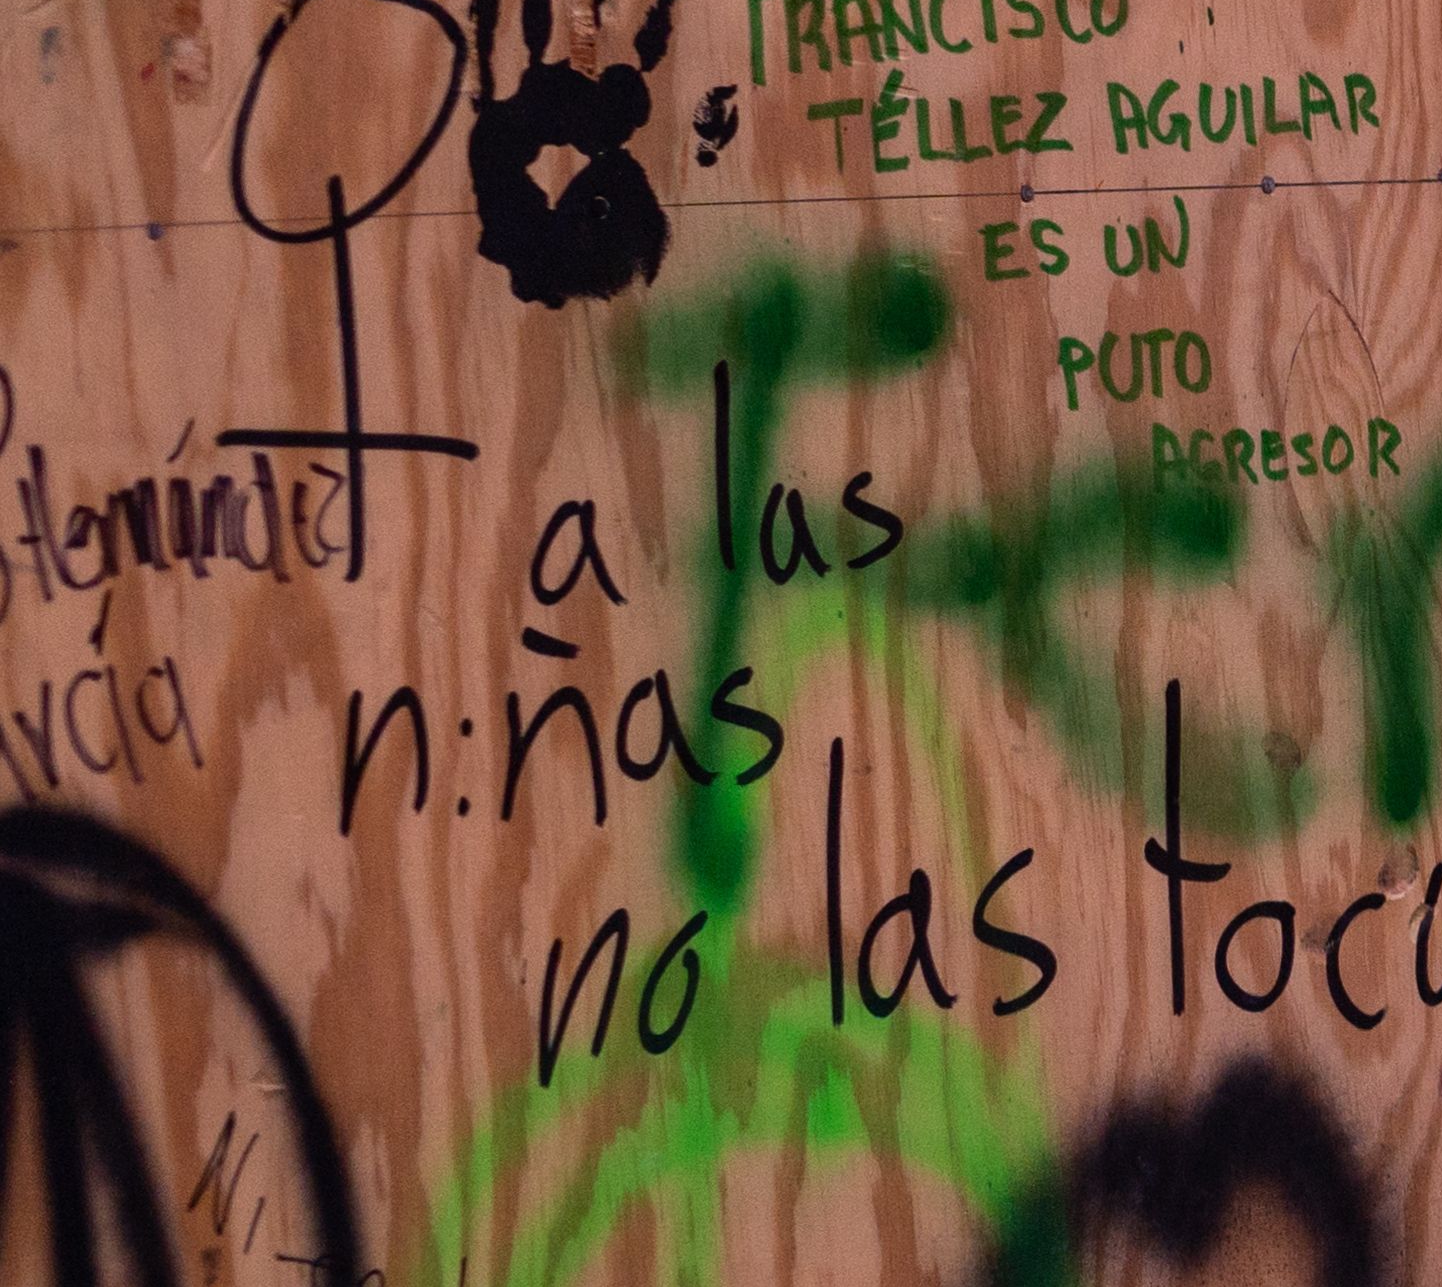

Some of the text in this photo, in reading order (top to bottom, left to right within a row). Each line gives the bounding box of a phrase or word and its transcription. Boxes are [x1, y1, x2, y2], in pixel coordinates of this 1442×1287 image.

[805, 67, 1382, 176] TÉLLEZ AGUILAR
[977, 194, 1192, 282] ES UN
[1057, 326, 1216, 412] PUTO
[528, 358, 905, 610] a las
[1150, 415, 1404, 492] AGRESOR
[538, 904, 710, 1090] no
[826, 734, 1062, 1030] las
